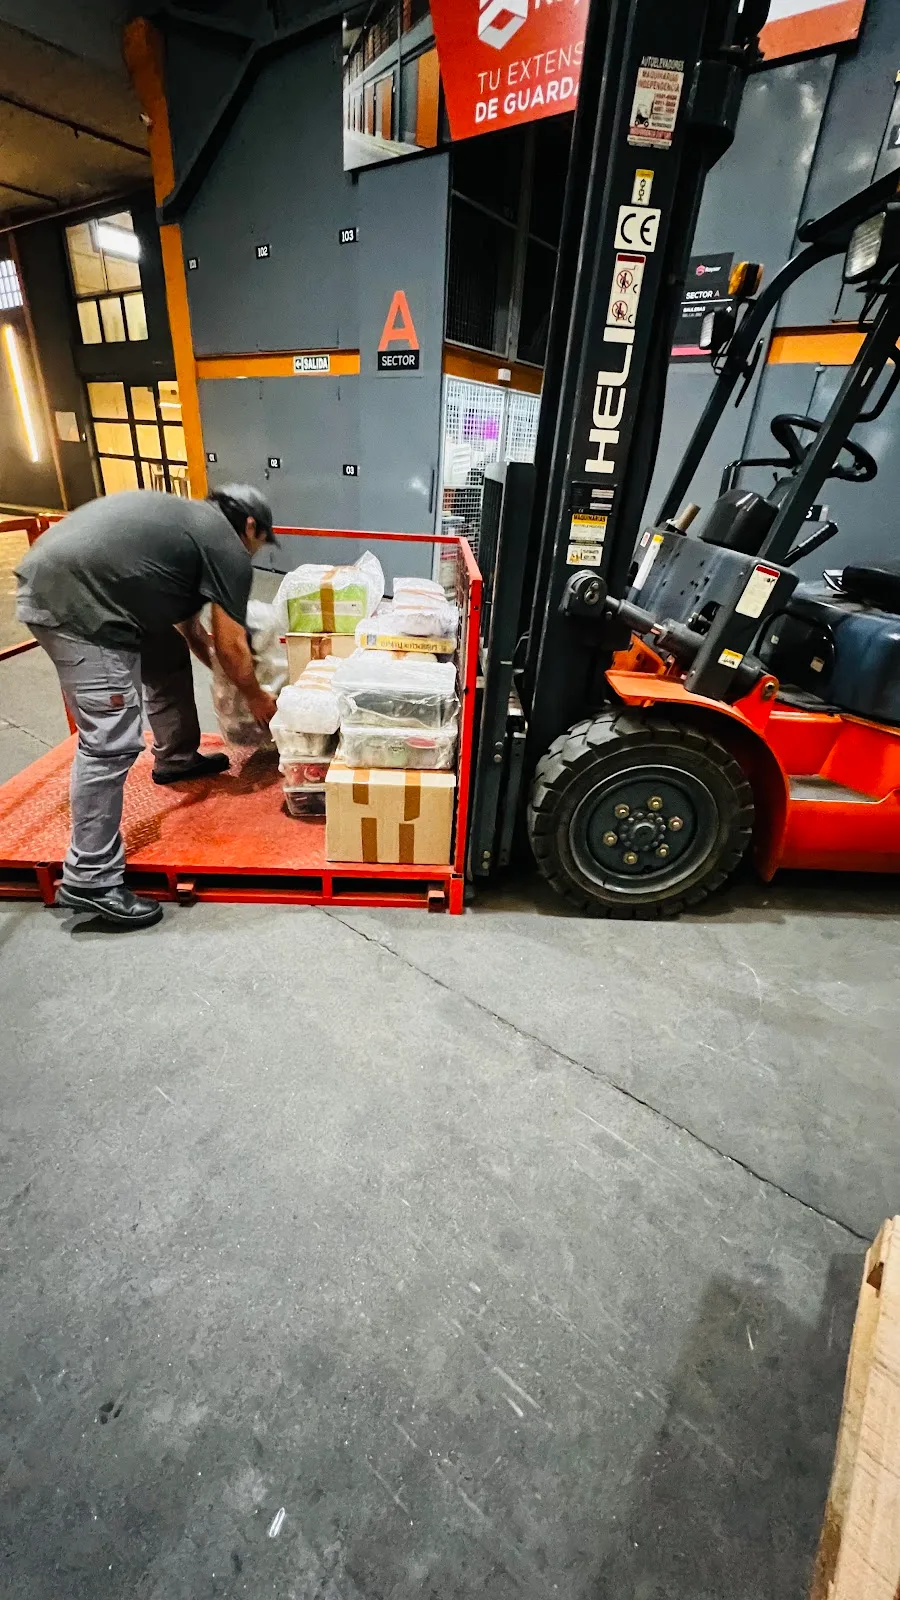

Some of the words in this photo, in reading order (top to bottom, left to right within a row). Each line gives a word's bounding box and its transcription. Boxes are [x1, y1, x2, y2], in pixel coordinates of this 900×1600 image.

[477, 68, 501, 94] TU
[474, 98, 498, 123] DE
[504, 76, 580, 114] GUARD
[620, 213, 656, 246] CE
[341, 230, 354, 242] 103
[257, 246, 268, 257] 102
[686, 290, 713, 299] SECTOR
[378, 290, 419, 351] A
[303, 357, 329, 369] SALIDA
[381, 355, 416, 366] SECTOR
[585, 327, 635, 473] HELI
[208, 453, 215, 461] 01
[270, 459, 278, 467] 02
[345, 465, 355, 475] 03
